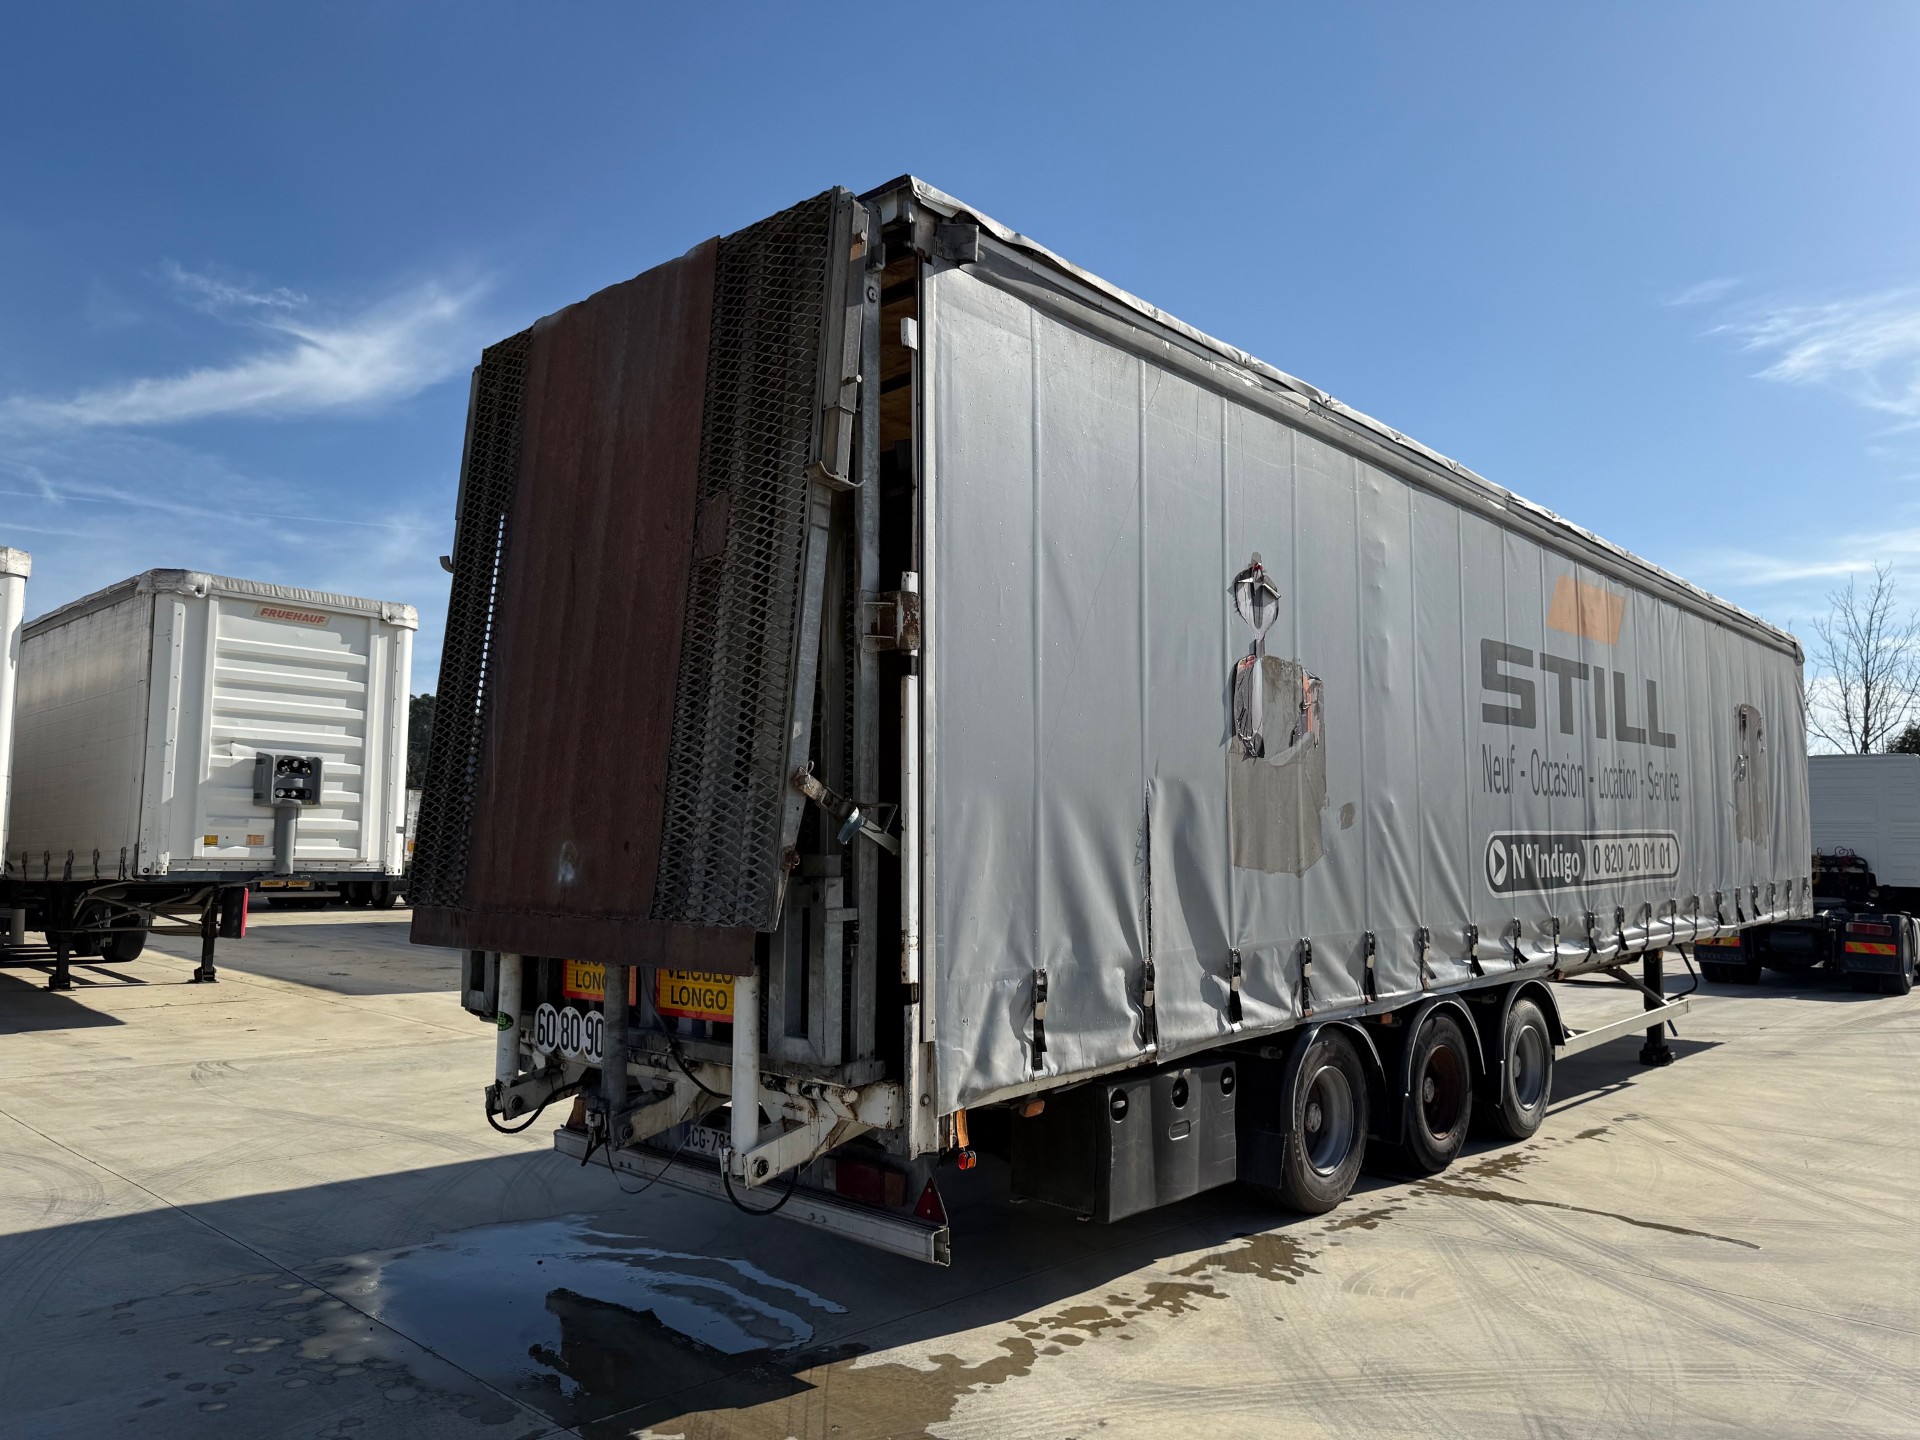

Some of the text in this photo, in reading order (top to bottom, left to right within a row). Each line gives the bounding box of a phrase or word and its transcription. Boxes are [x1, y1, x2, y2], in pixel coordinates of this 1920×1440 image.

[260, 607, 326, 624] FRUEHAUF
[1480, 637, 1677, 750] STILL
[1482, 743, 1515, 795] Neuf
[1530, 748, 1585, 798] Occasion
[1597, 757, 1638, 799] Location
[1647, 760, 1680, 801] Service
[1593, 844, 1601, 875] 0
[1604, 843, 1624, 874] 820
[1628, 842, 1641, 872] 20
[1644, 841, 1656, 871] 01
[1660, 841, 1671, 870] 01
[575, 969, 606, 991] LON
[670, 984, 728, 1011] LONGO
[537, 1007, 556, 1048] 60
[560, 1011, 581, 1053] 80
[584, 1015, 604, 1058] 90
